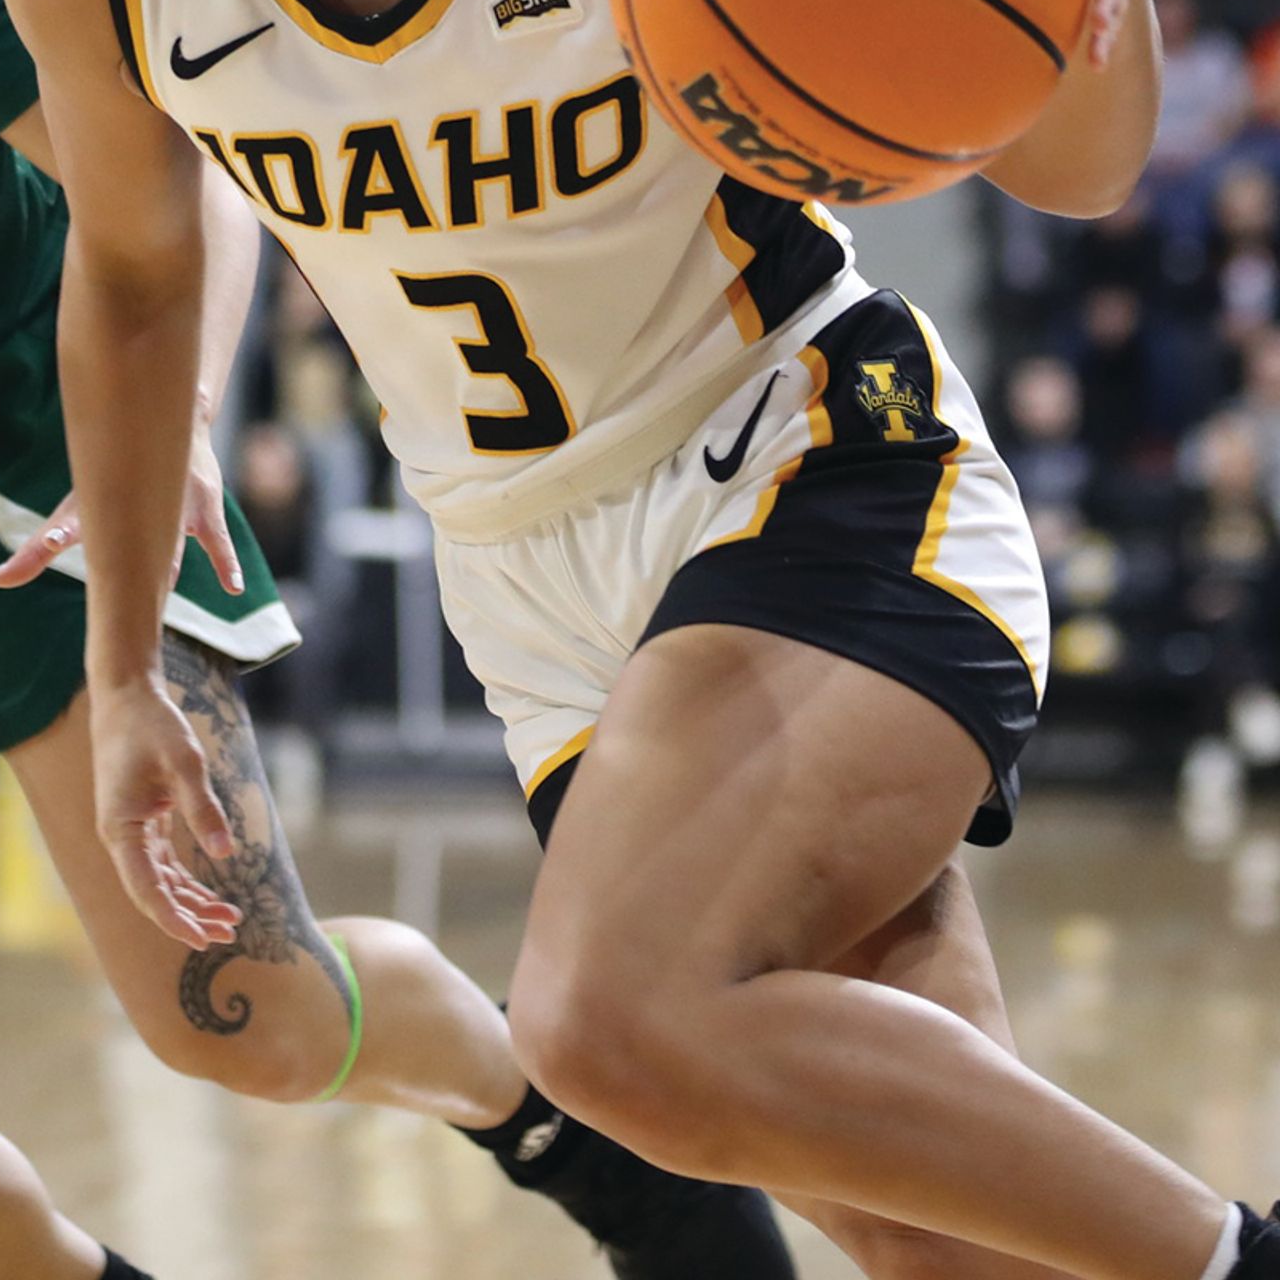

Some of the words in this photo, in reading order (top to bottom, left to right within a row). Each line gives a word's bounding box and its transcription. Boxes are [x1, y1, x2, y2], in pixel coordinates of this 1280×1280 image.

[192, 69, 648, 233] IDAHO
[680, 73, 896, 203] NCAA
[391, 268, 578, 457] 3
[858, 384, 919, 414] Vandals
